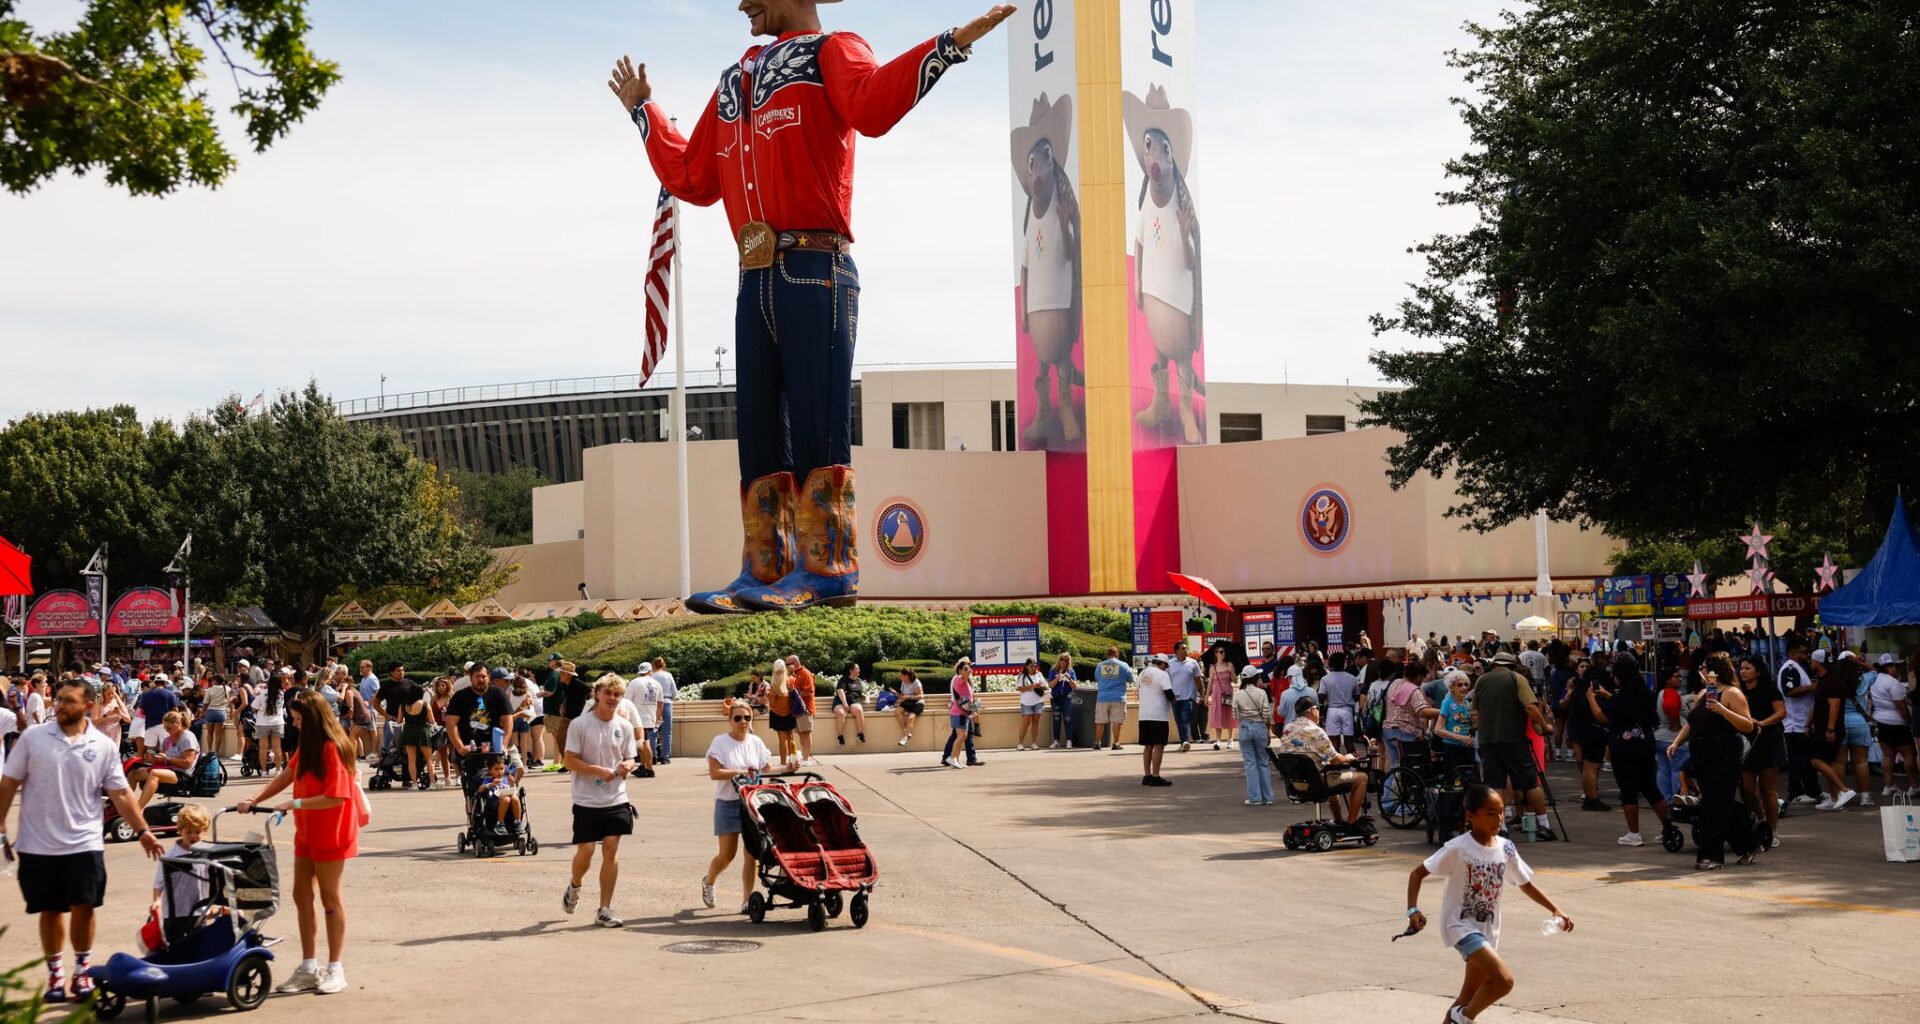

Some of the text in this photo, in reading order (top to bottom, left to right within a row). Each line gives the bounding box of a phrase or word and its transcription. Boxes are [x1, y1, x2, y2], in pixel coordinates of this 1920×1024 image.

[744, 231, 766, 255] Shiner
[1740, 600, 1753, 612] ICED
[1755, 599, 1767, 611] TEA
[1771, 597, 1805, 612] ICED
[35, 611, 88, 620] COTTON
[117, 609, 172, 618] COTTON
[40, 620, 86, 629] CANDY
[121, 618, 169, 627] CANDY
[975, 628, 1004, 638] BELT BUCKLE
[1277, 631, 1294, 641] COURT
